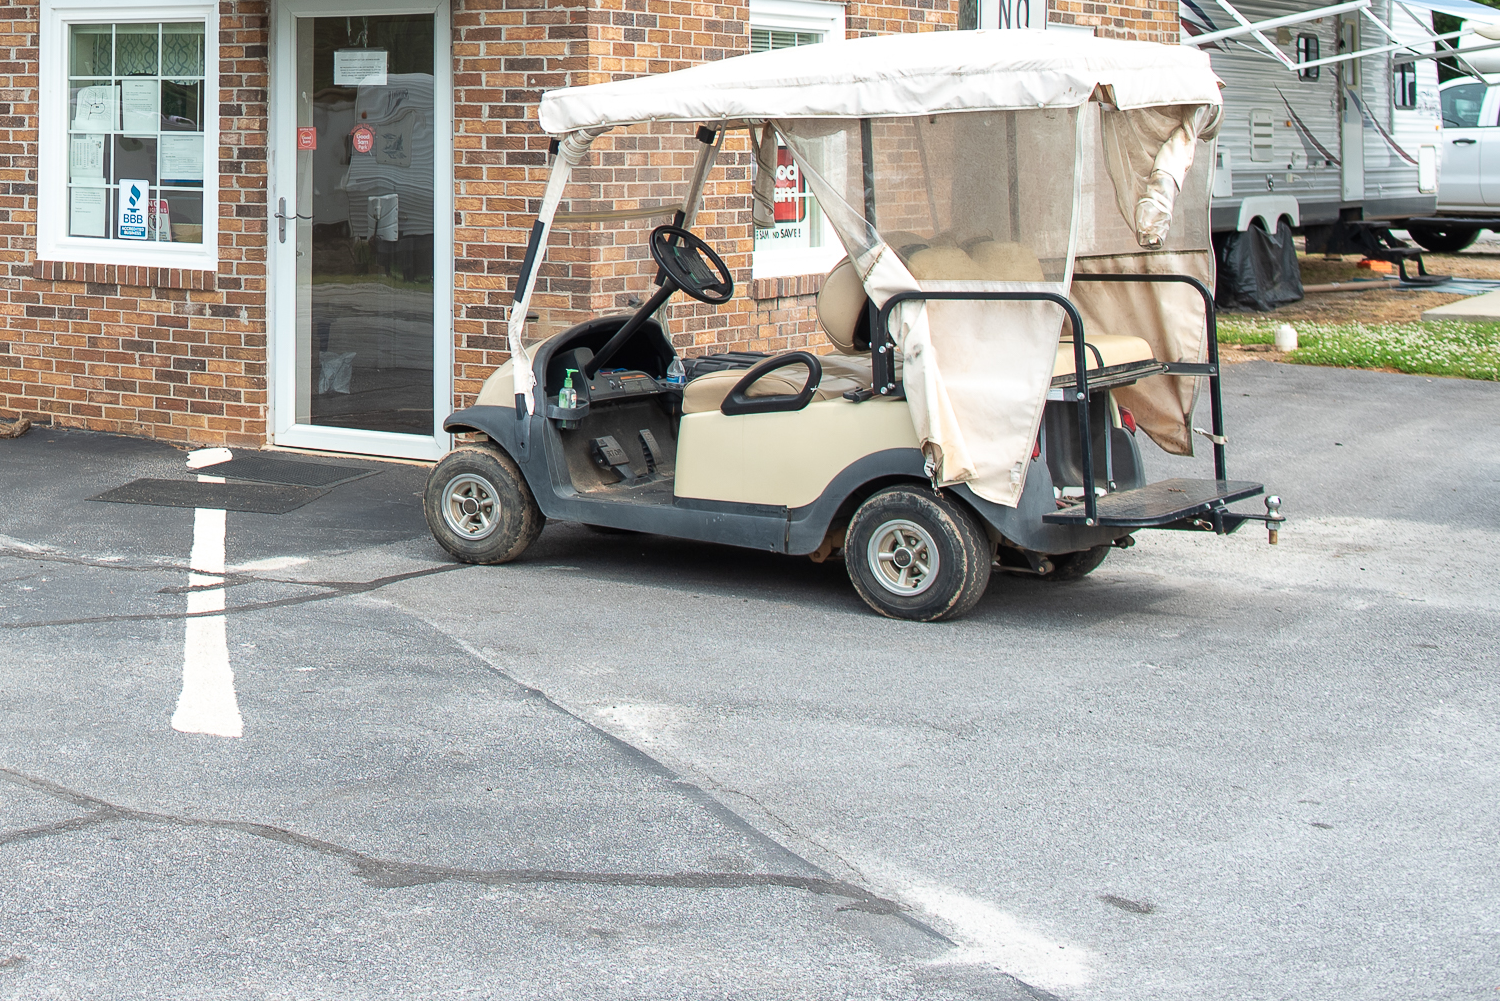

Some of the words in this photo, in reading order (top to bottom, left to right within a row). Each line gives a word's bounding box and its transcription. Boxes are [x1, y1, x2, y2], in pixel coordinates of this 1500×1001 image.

[776, 159, 799, 181] od
[774, 187, 798, 203] am
[123, 214, 143, 223] BBB
